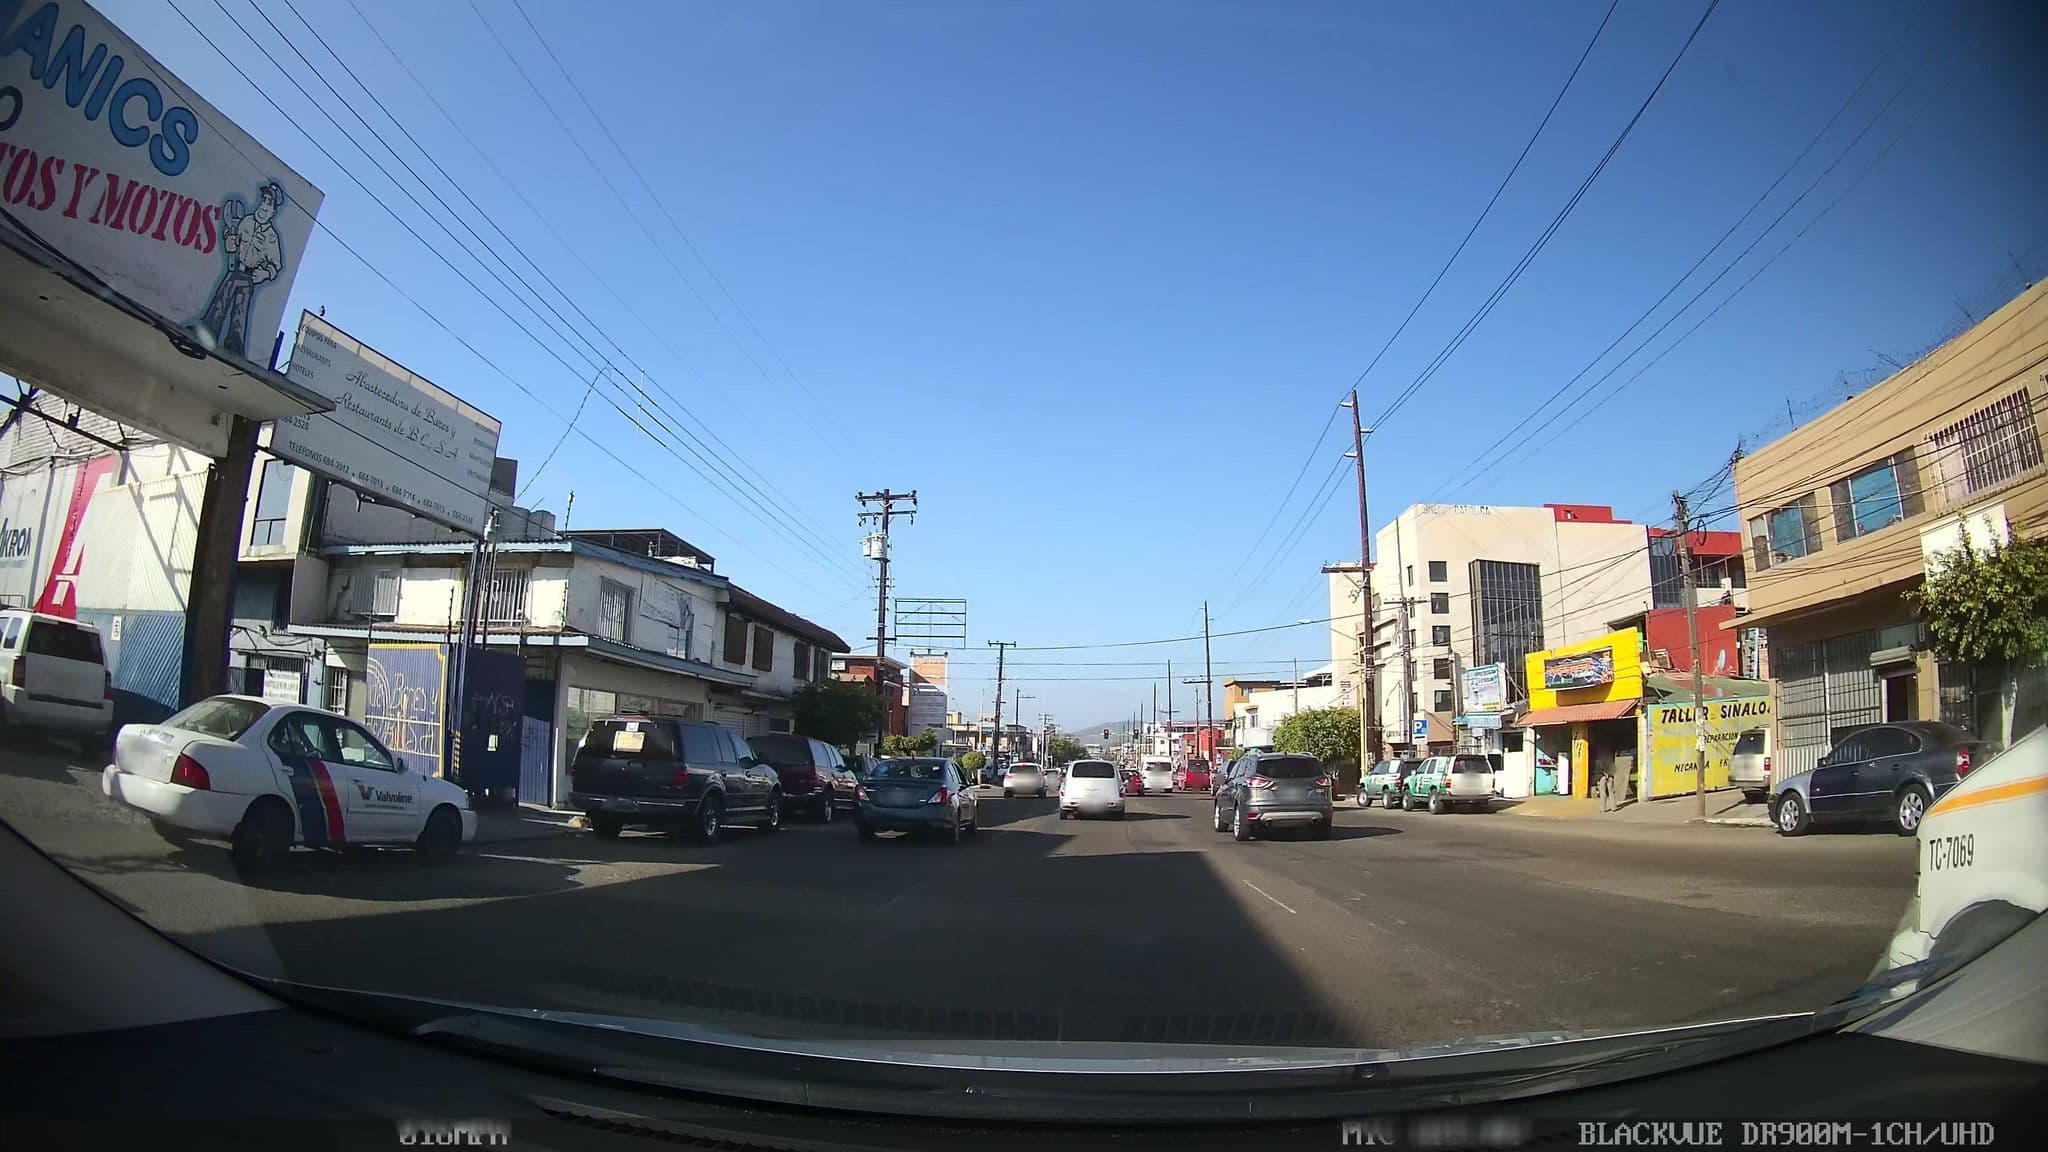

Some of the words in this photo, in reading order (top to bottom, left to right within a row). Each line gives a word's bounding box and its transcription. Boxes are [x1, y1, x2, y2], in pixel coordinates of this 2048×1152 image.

[0, 0, 199, 177] ANICS
[63, 163, 99, 220] Y
[89, 173, 222, 255] MOTOS
[335, 392, 392, 429] Restaurants
[394, 420, 405, 435] de
[346, 371, 409, 411] Abastecedora
[411, 400, 422, 417] de
[423, 408, 449, 432] Bares
[289, 440, 322, 463] TELEFONOS
[1661, 707, 1709, 724] TALLR
[1674, 761, 1710, 773] MECANA
[375, 790, 413, 804] Valvoline
[1929, 833, 1974, 871] TC-7069
